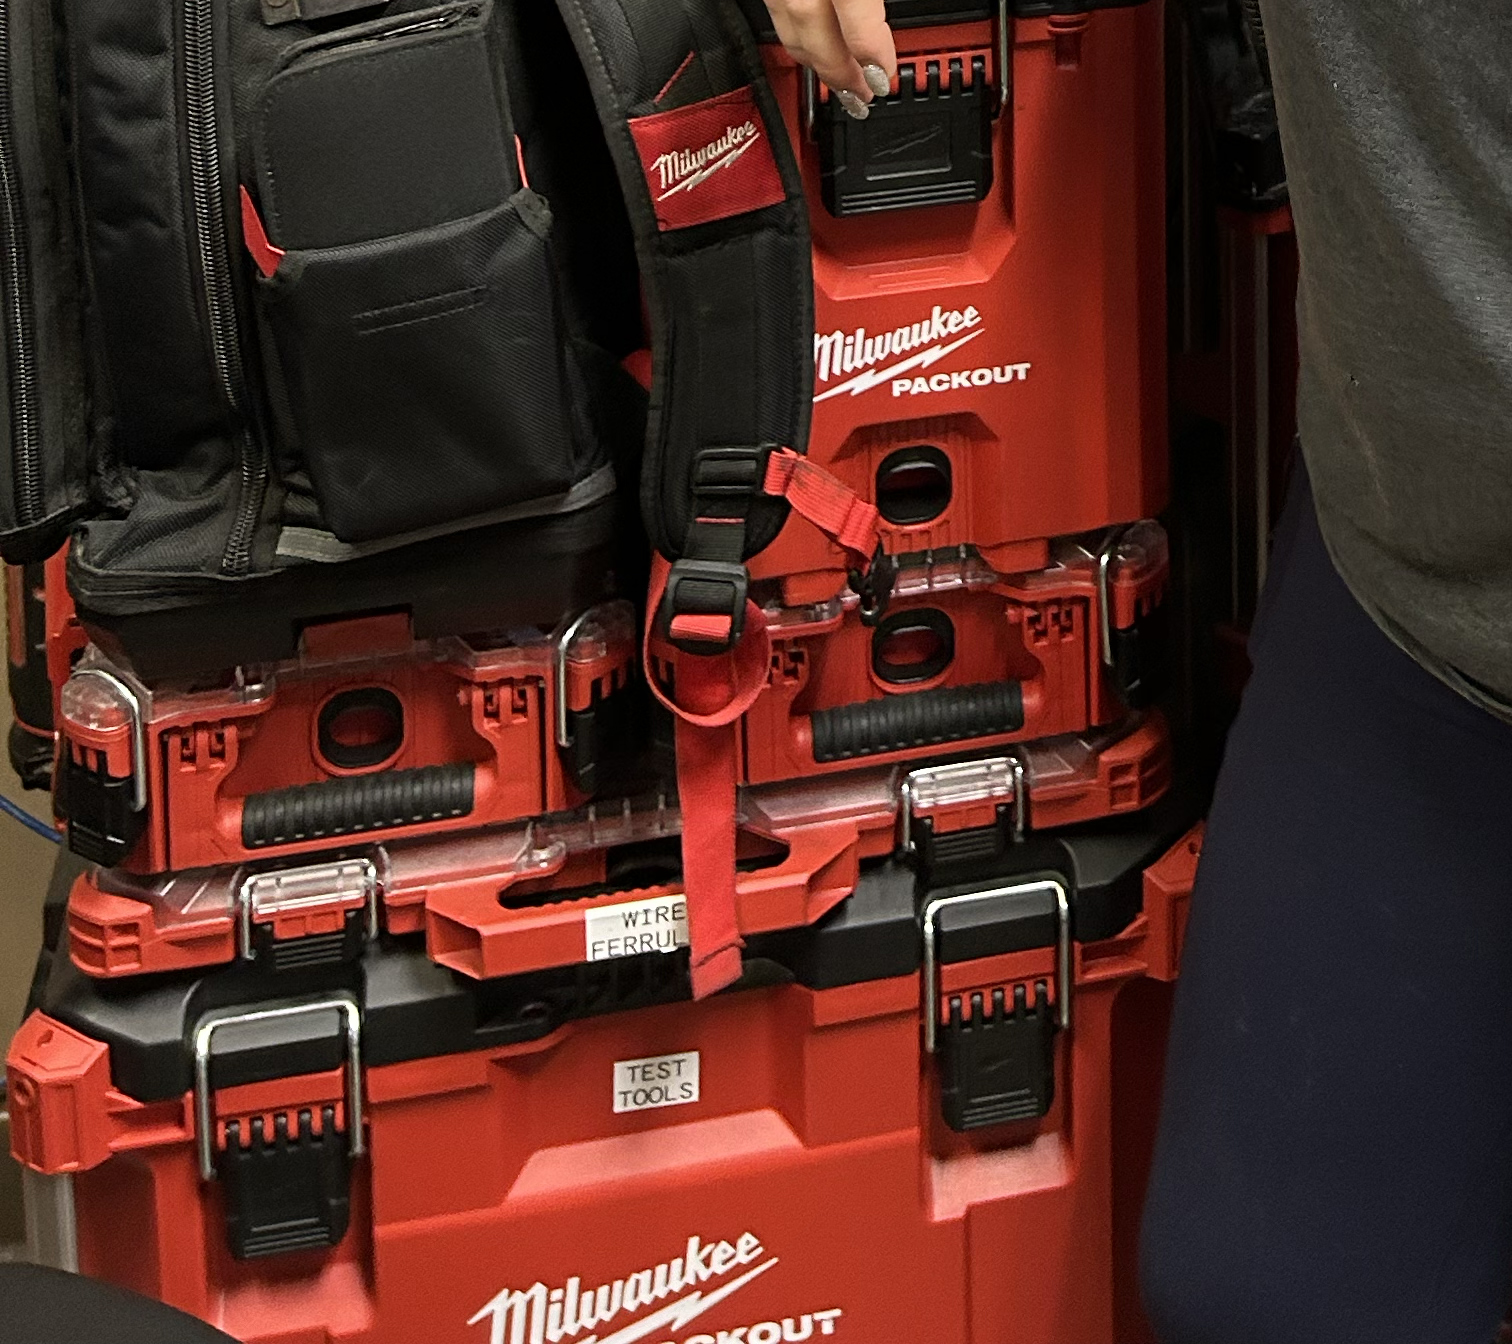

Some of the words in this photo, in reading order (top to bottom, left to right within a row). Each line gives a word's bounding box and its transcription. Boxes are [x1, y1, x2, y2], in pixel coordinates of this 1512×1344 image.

[651, 120, 756, 189] Milwaukee
[813, 303, 981, 378] Milwaukee
[891, 362, 1030, 398] PACKOUT
[622, 903, 686, 926] WIRE
[627, 1060, 687, 1082] TEST
[618, 1081, 693, 1106] TOOLS
[467, 1232, 764, 1344] Milwaukee
